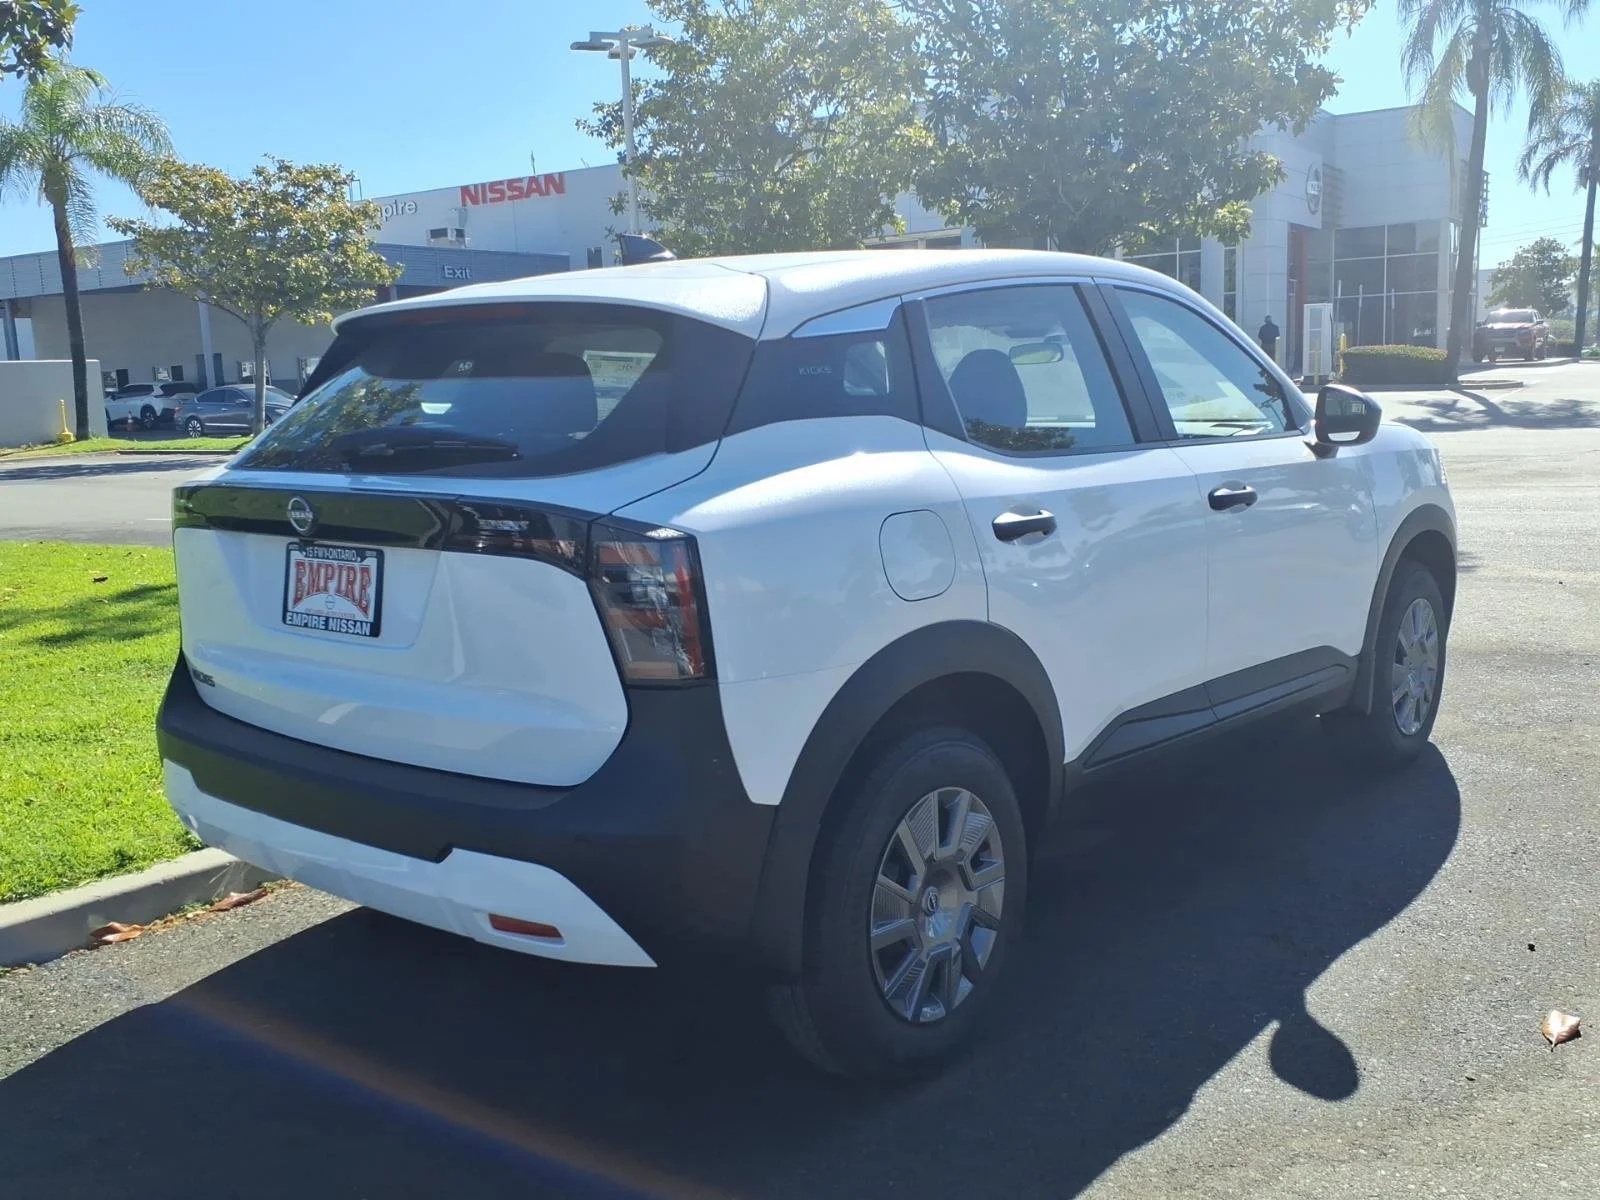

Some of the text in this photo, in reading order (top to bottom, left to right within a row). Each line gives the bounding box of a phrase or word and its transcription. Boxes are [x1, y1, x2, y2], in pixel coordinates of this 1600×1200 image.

[460, 172, 565, 207] NISSAN
[374, 199, 418, 222] pire
[443, 264, 472, 281] Exit
[292, 559, 371, 619] EMPIRE
[286, 611, 326, 631] EMPIRE
[328, 618, 371, 636] NISSAN
